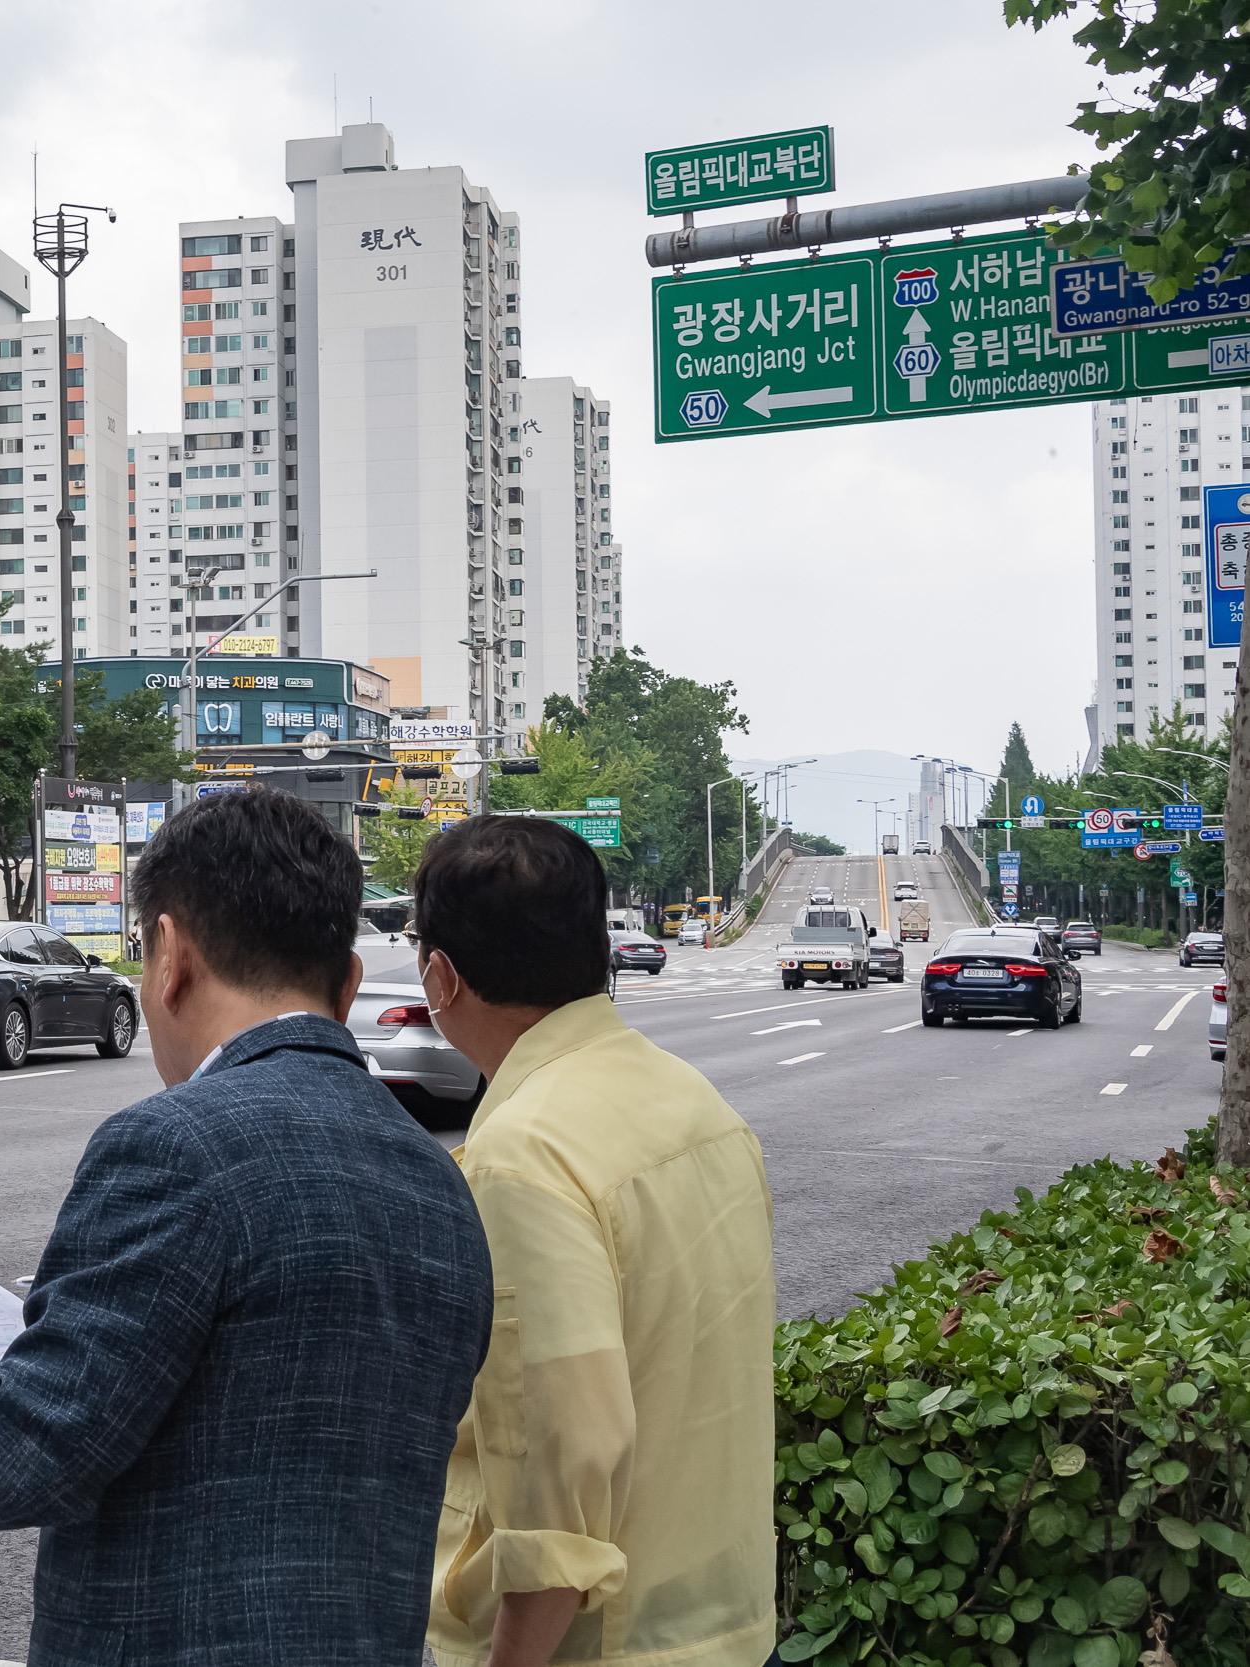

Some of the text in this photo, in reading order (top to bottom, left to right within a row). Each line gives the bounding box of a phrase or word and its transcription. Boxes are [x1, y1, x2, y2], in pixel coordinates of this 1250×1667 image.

[654, 141, 821, 199] 올림픽대교북단
[360, 225, 422, 251] 現代
[376, 265, 407, 281] 301
[949, 246, 1045, 292] 서하남
[902, 281, 931, 301] 100
[672, 284, 858, 346] 광장사거리
[1064, 299, 1200, 326] Gwangnaru-ro
[675, 335, 856, 379] Gwangjang Jct
[904, 349, 929, 372] 60
[950, 361, 1109, 402] Olympicdaegyo(Br)
[689, 395, 719, 422] 50
[223, 638, 275, 652] 010-2124-6797
[169, 675, 279, 689] 마이 닿는 치과의원
[265, 713, 315, 727] 임플란트
[319, 713, 344, 729] 사랑니
[390, 725, 472, 740] 해강수학학원
[1096, 815, 1110, 824] 50
[66, 847, 96, 868] 요양보호사
[71, 876, 82, 891] 위한
